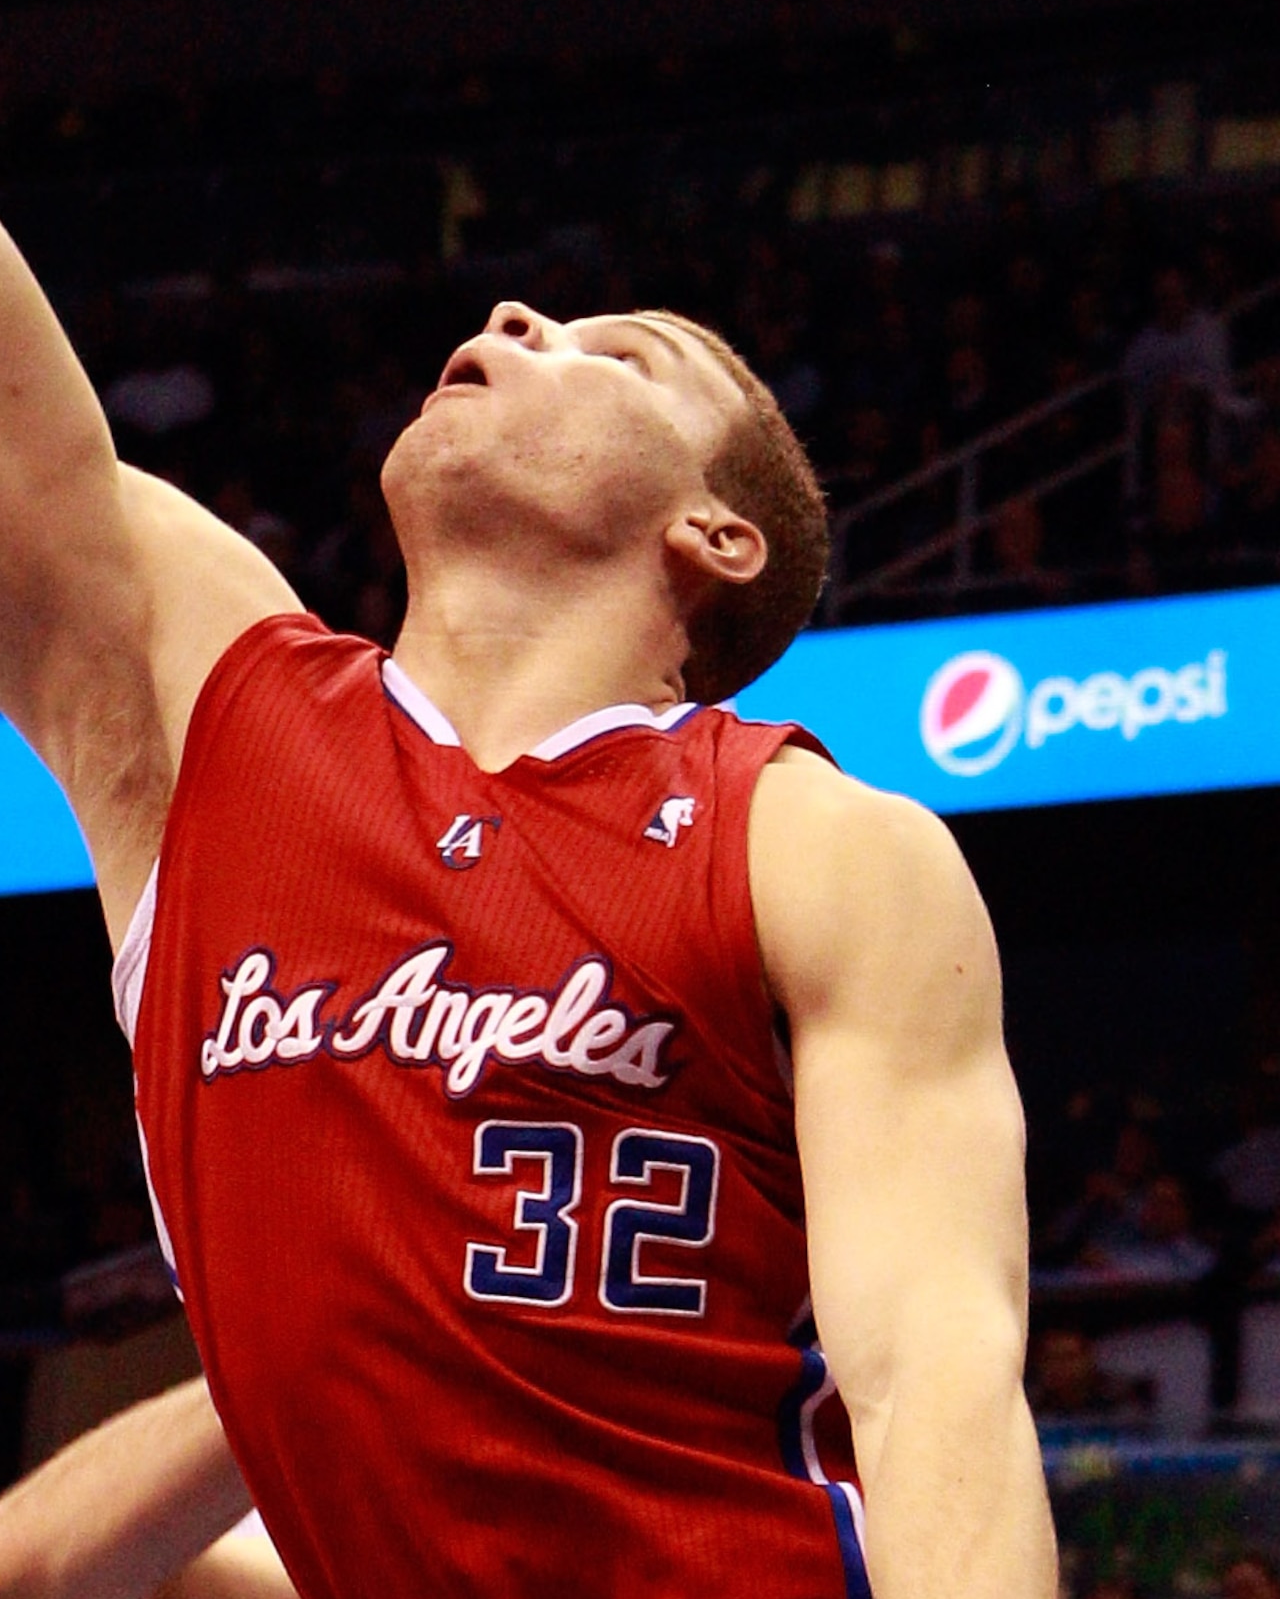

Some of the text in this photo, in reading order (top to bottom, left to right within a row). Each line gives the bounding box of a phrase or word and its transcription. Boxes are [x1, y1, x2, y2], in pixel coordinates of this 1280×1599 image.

[1025, 649, 1229, 749] pepsi
[200, 938, 680, 1098] Los Angeles
[462, 1119, 721, 1317] 32
